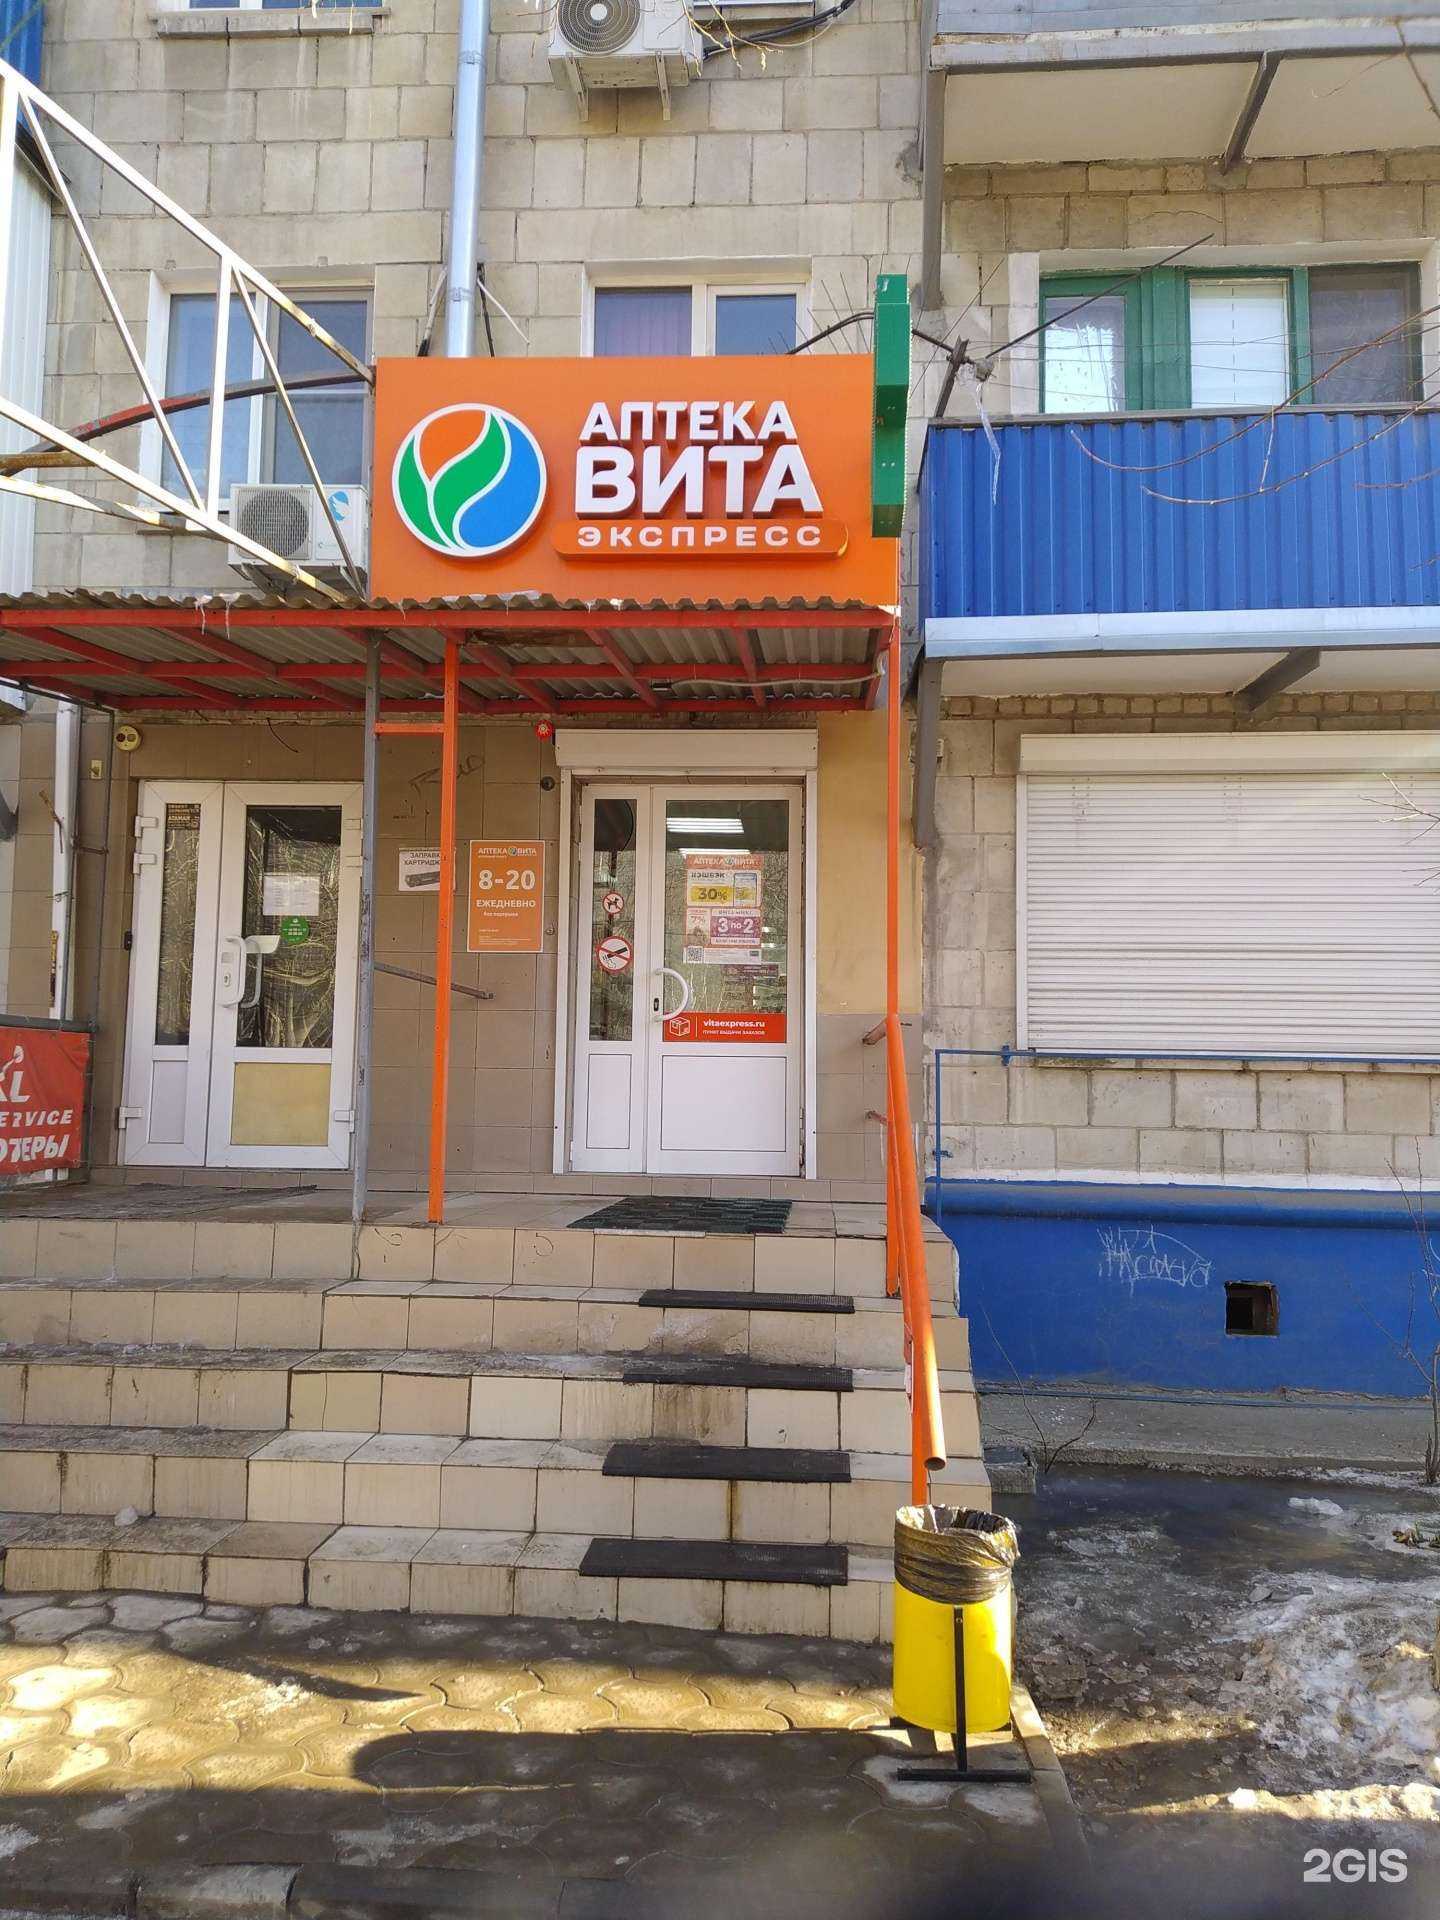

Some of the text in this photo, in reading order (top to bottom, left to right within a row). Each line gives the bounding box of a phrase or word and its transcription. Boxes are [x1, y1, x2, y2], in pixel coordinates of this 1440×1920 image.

[578, 400, 799, 441] АПТЕКА
[574, 444, 825, 515] ВИТА
[577, 526, 821, 547] ЭКСПРЕСС
[478, 847, 508, 855] АПТЕКА
[478, 869, 536, 890] 8-20
[698, 887, 728, 901] 30%
[476, 899, 536, 909] ЕЖЕДНЕВНО
[718, 917, 729, 933] 3
[743, 918, 754, 934] 2
[703, 1019, 765, 1028] vitaexpress.ru
